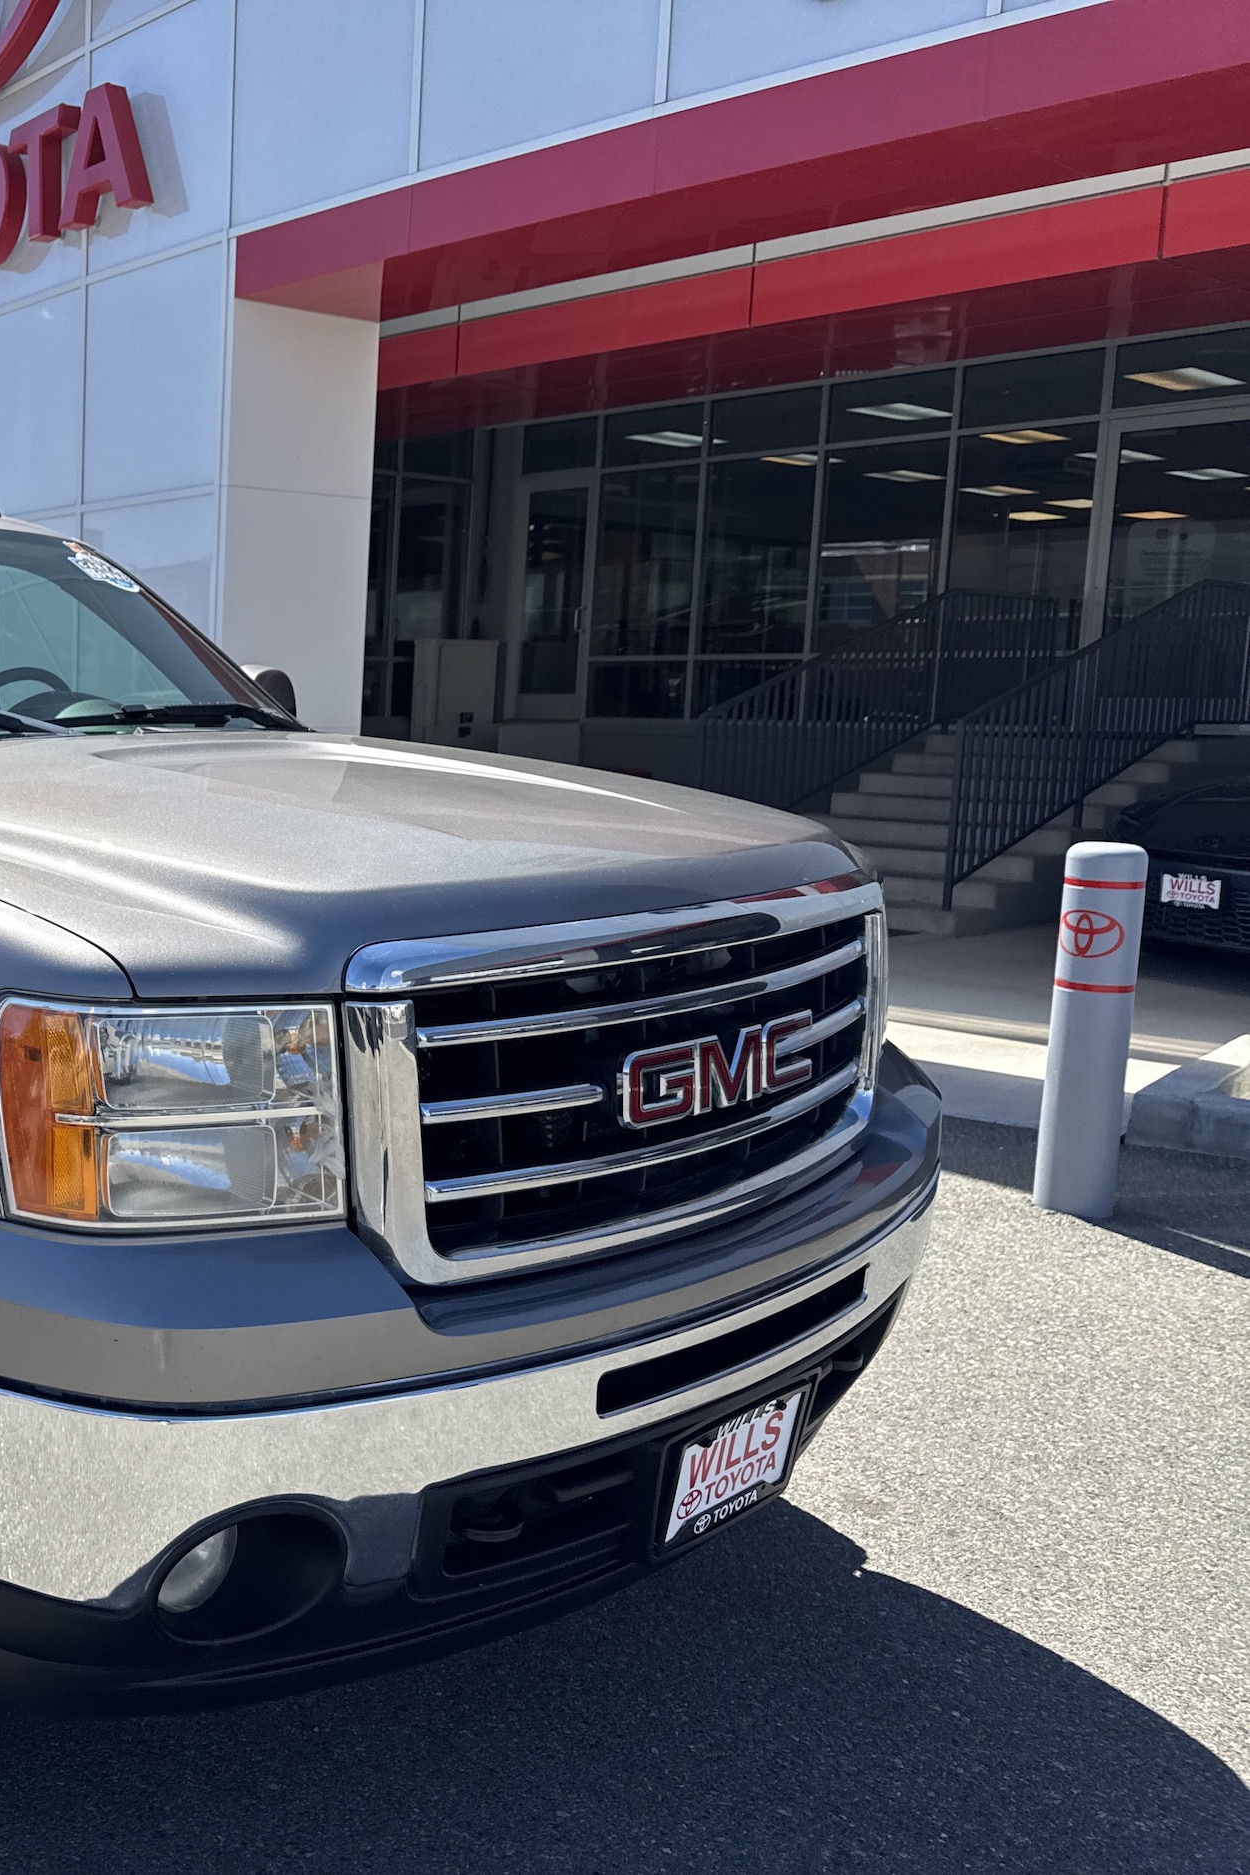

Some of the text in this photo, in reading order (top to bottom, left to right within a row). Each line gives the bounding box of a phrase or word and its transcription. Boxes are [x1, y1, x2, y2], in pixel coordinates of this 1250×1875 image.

[1171, 879, 1216, 896] WILLS
[1180, 892, 1216, 903] TOYOTA
[622, 1009, 813, 1130] GMC
[716, 1399, 777, 1439] WILLS
[689, 1411, 784, 1489] WILLS
[705, 1451, 777, 1505] TOYOTA
[713, 1490, 758, 1523] TOYOTA
